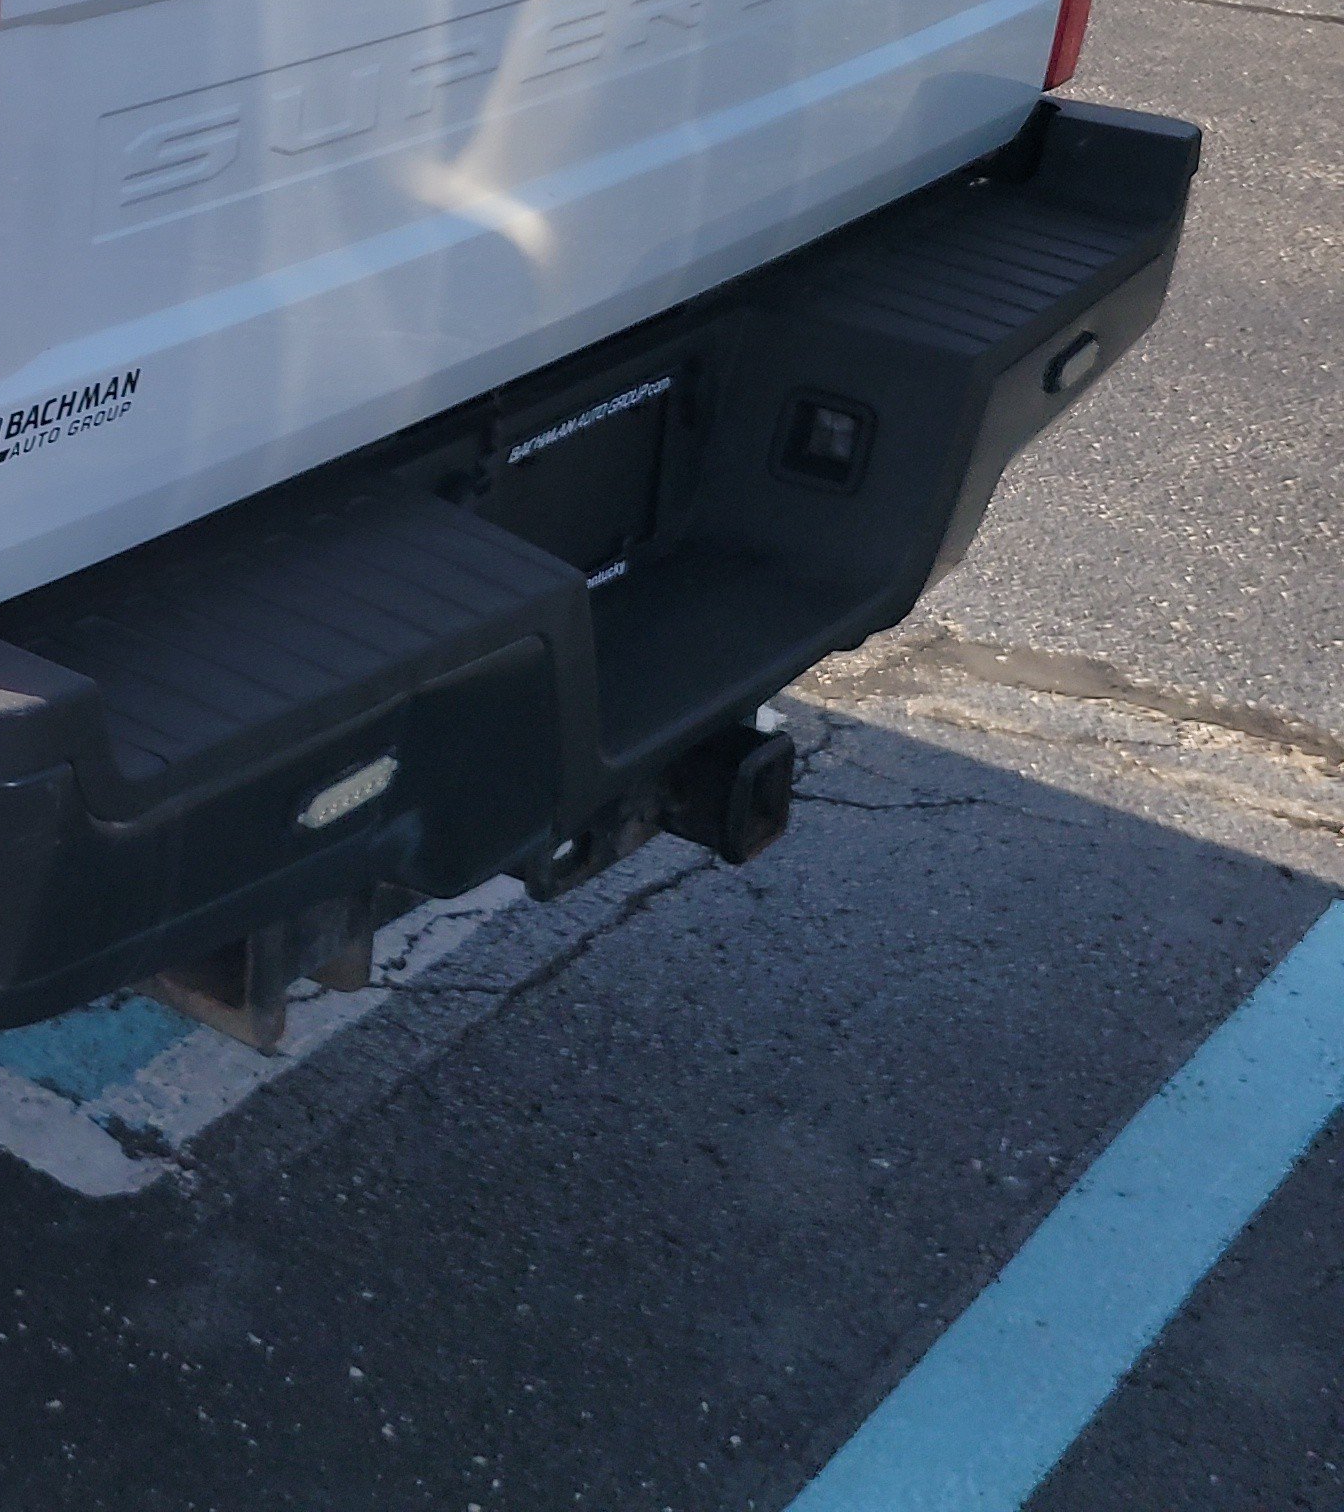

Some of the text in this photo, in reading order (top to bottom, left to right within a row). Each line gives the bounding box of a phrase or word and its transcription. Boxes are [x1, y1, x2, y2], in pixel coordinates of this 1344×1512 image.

[4, 367, 142, 440] BACHMAN
[8, 400, 133, 460] AUTO GROUP
